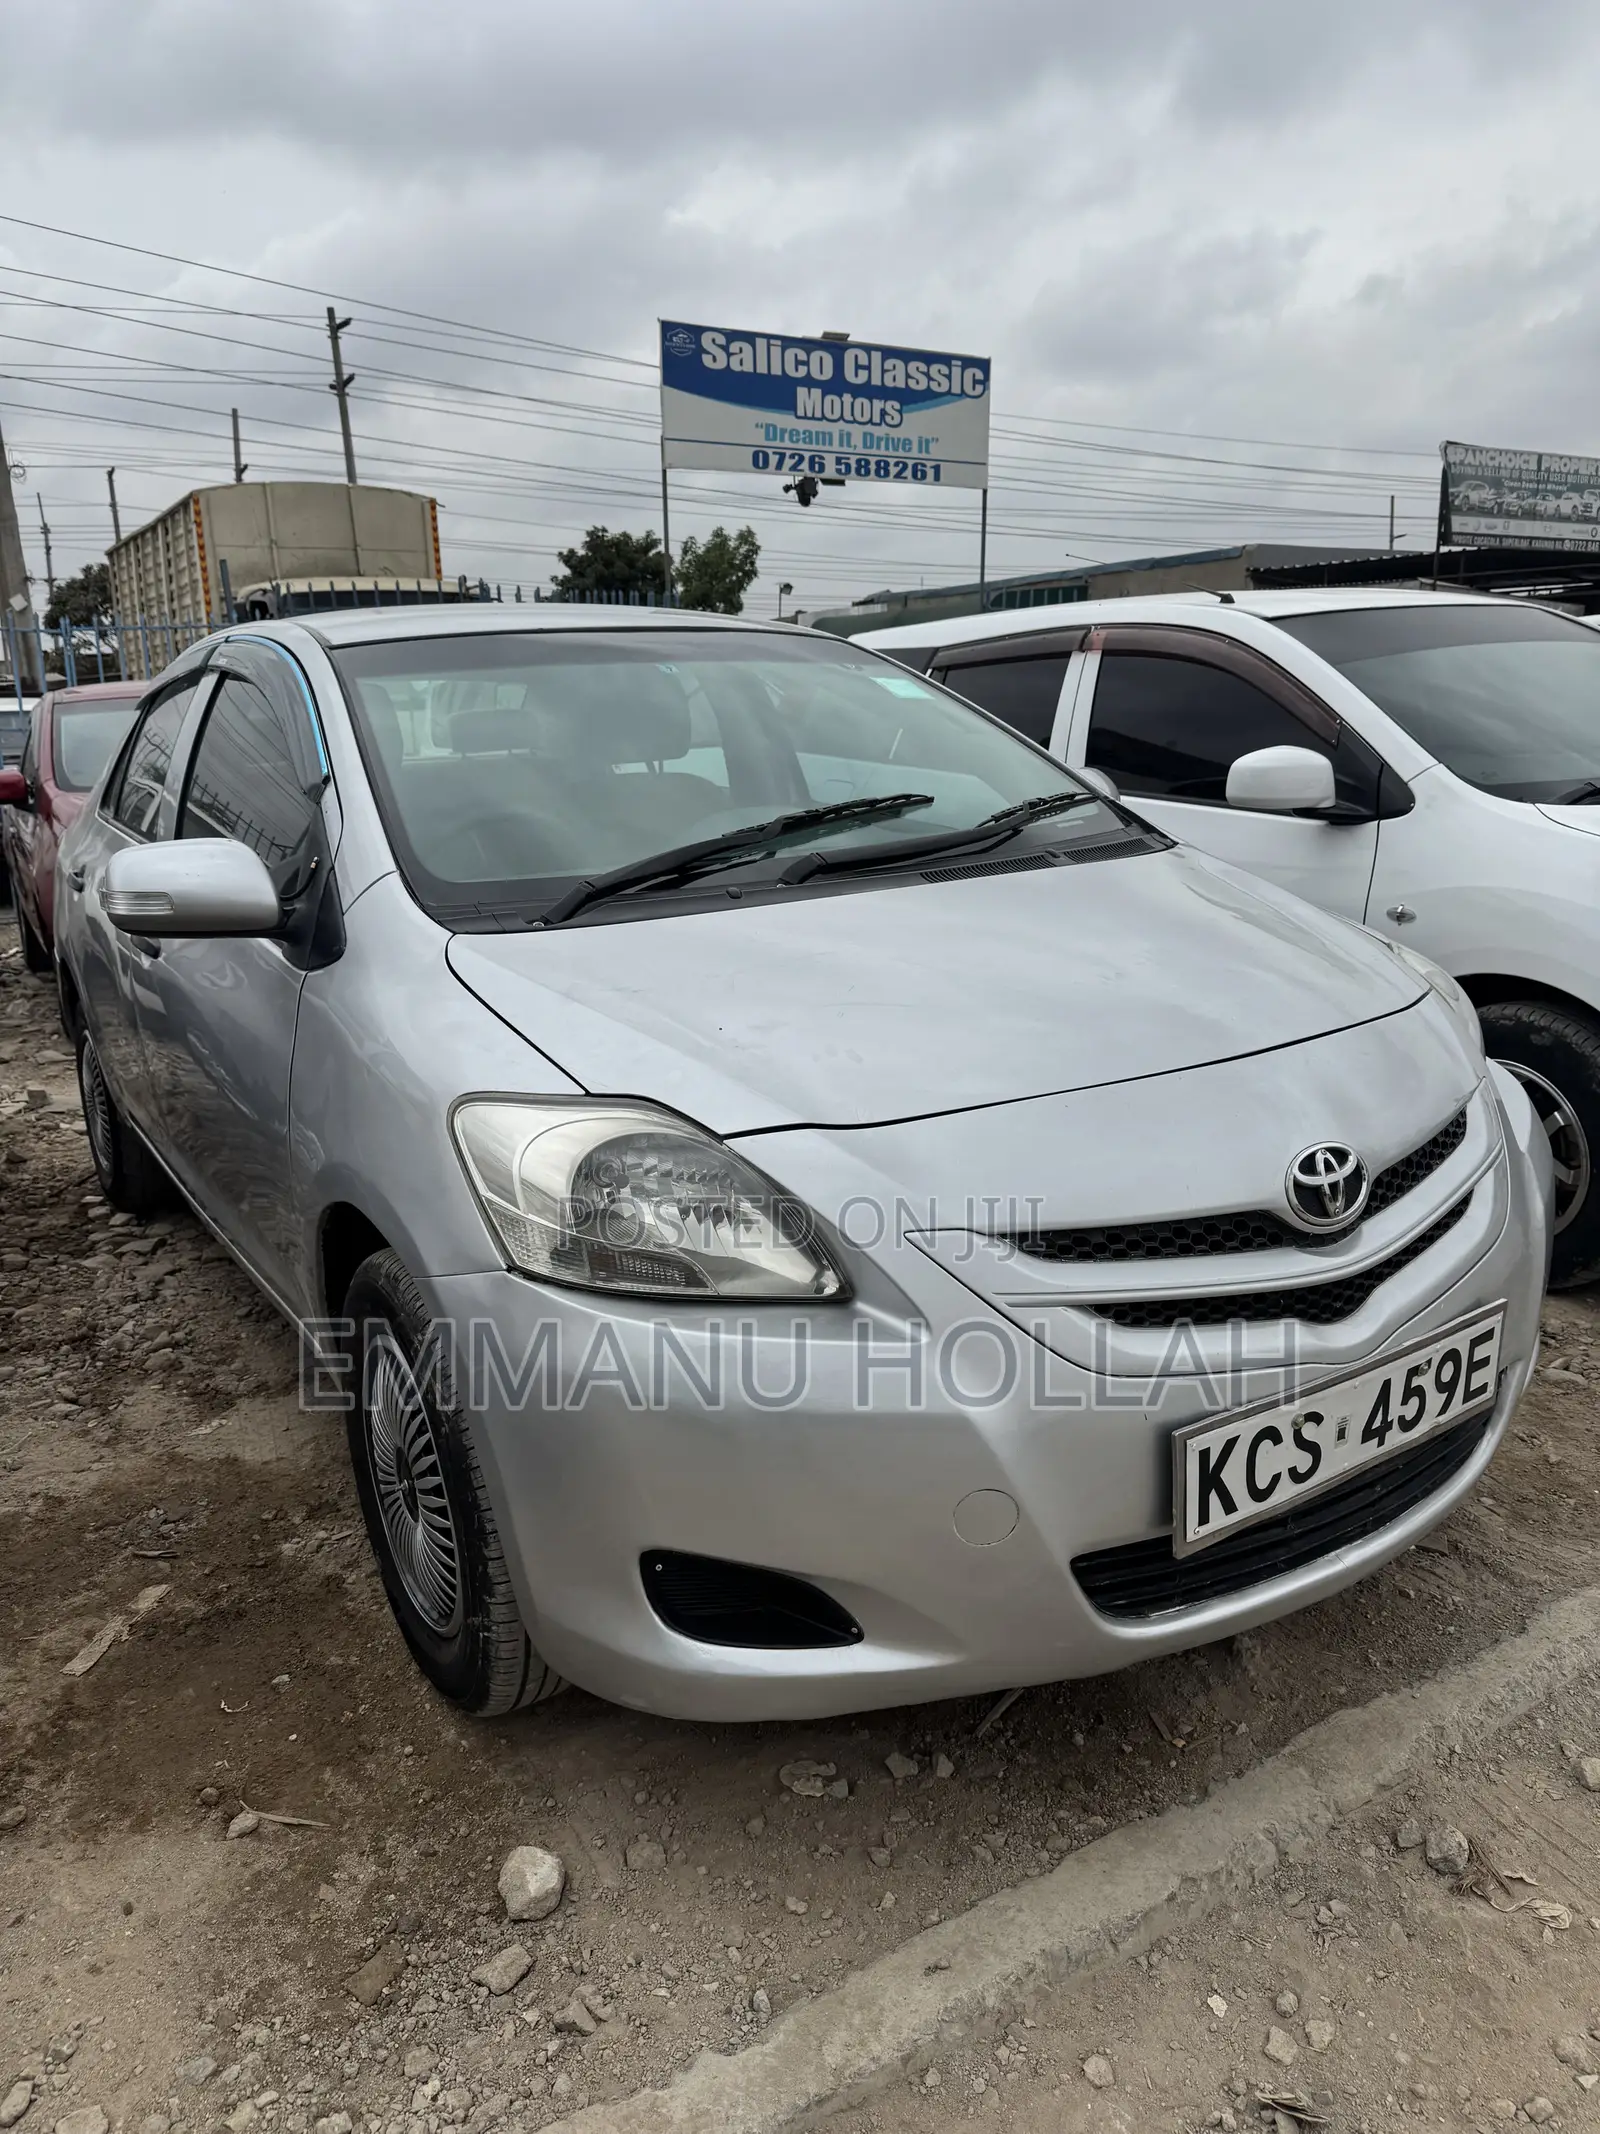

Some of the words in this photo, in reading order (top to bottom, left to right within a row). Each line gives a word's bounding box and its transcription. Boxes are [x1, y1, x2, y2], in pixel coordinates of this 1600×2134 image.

[700, 331, 834, 381] Salico
[844, 347, 986, 397] Classic
[796, 387, 902, 427] Motors
[839, 430, 858, 452] it,
[862, 431, 914, 453] Drive
[752, 450, 826, 474] 0726
[835, 458, 942, 483] 588261
[1522, 471, 1548, 481] QUALITY
[1550, 472, 1566, 482] USED
[1568, 474, 1588, 484] MOTOR
[1571, 540, 1587, 552] 0722
[1197, 1411, 1325, 1527] KCS
[1361, 1326, 1496, 1449] 459E
